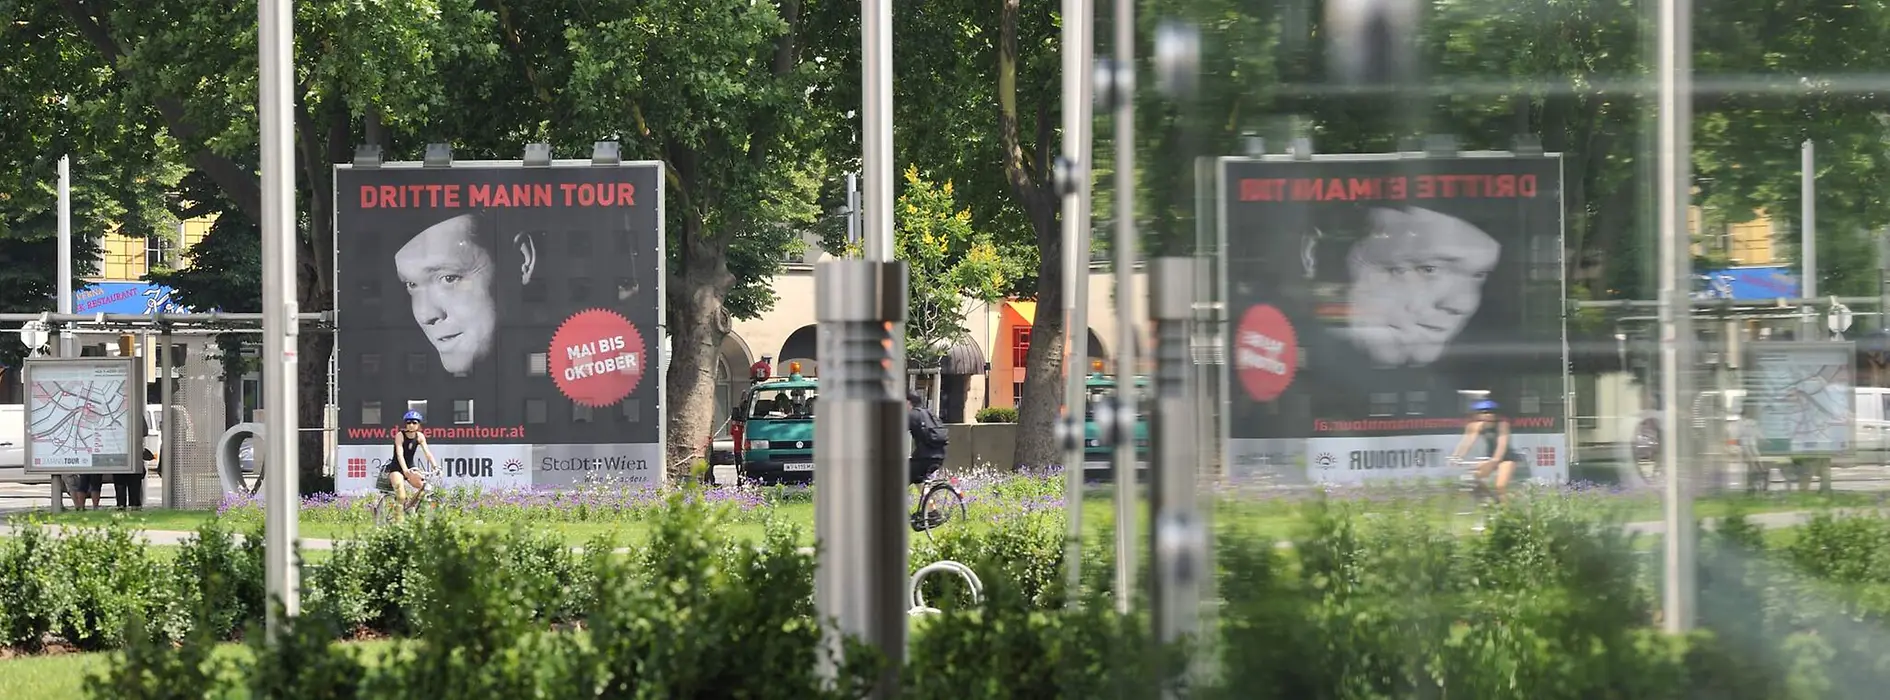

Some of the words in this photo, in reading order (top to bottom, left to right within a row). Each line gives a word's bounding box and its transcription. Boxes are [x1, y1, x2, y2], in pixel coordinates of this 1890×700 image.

[360, 185, 460, 209] DRITTE
[468, 184, 552, 207] MANN
[560, 183, 635, 206] TOUR
[87, 287, 138, 310] RESTAURANT
[566, 341, 597, 360] MAI
[598, 335, 625, 353] BIS
[564, 354, 637, 381] OKTOBER
[348, 425, 525, 439] www.demanntour.at
[604, 455, 648, 470] Wien
